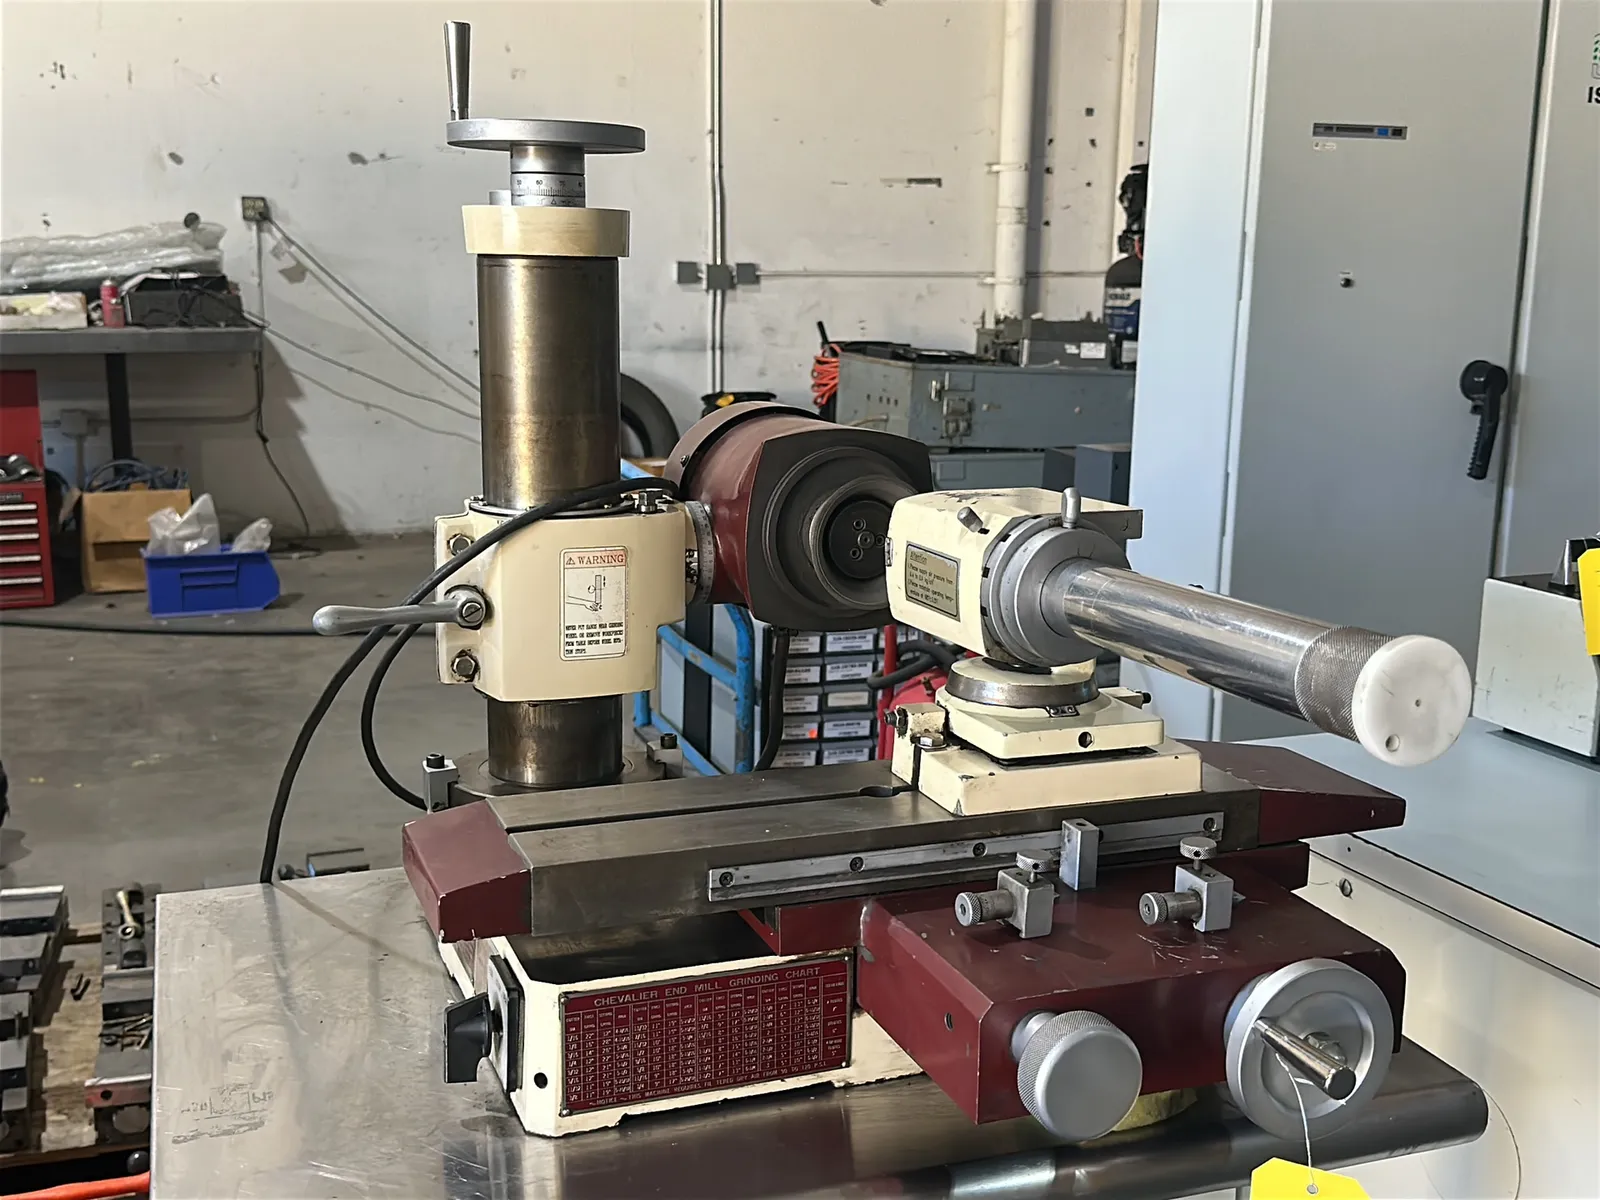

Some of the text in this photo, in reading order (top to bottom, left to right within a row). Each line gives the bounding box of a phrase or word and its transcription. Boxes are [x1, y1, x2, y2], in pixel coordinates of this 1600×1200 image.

[578, 554, 624, 564] WARNING
[594, 967, 820, 1007] CHEVALIER END MILL GRINDING CHART
[674, 1084, 701, 1092] REQUIRES
